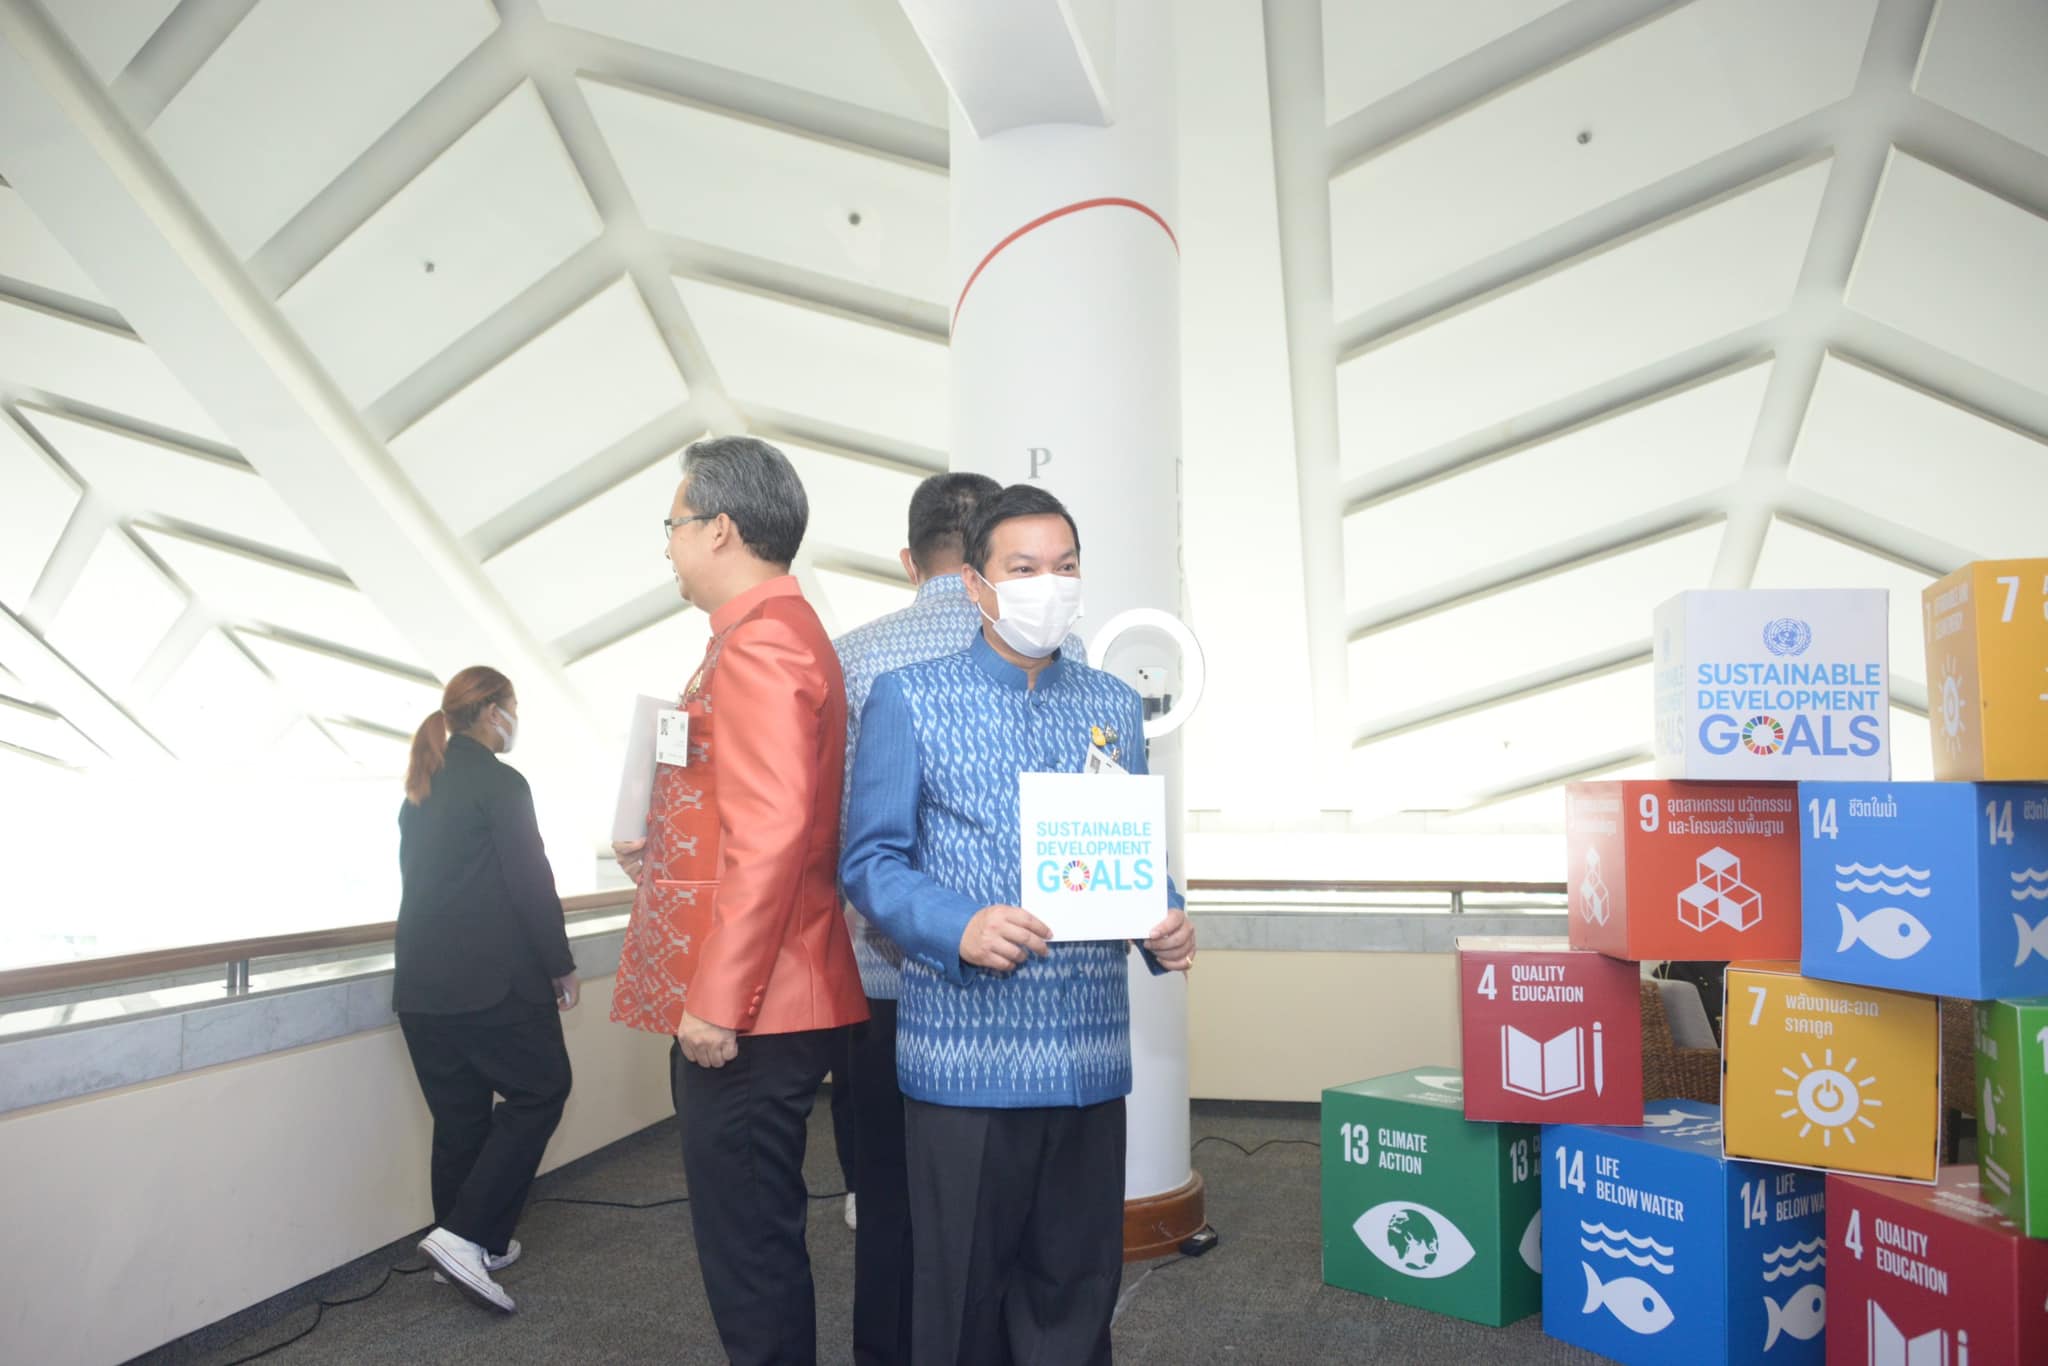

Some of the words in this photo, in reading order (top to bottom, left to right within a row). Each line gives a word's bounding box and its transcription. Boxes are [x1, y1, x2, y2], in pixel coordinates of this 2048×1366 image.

[1027, 447, 1052, 479] P
[1996, 576, 2019, 622] 7
[1697, 663, 1881, 686] SUSTAINABLE
[1699, 690, 1880, 711] DEVELOPMENT
[1699, 714, 1881, 756] GOALS
[1639, 793, 1660, 833] 9
[1667, 799, 1735, 816] อุตสาหกรรม
[1738, 796, 1792, 812] นวัตกรรม
[1808, 798, 1839, 840] 14
[1986, 800, 2015, 846] 14
[1036, 821, 1152, 837] SUSTAINABLE
[1036, 841, 1152, 856] DEVELOPMENT
[1037, 859, 1153, 893] GOALS
[1477, 964, 1497, 1000] 4
[1512, 965, 1565, 983] QUALITY
[1512, 985, 1584, 1003] EDUCATION
[1747, 986, 1767, 1025] 7
[1340, 1122, 1369, 1165] 13
[1378, 1127, 1427, 1153] CLIMATE
[1378, 1150, 1422, 1175] ACTION
[1510, 1139, 1528, 1184] 13
[1555, 1146, 1586, 1194] 14
[1595, 1154, 1620, 1179] LIFE
[1596, 1179, 1638, 1209] BELOW
[1640, 1189, 1684, 1222] WATER
[1775, 1173, 1796, 1196] LIFE
[1740, 1179, 1767, 1229] 14
[1775, 1195, 1810, 1222] BELOW
[1845, 1208, 1863, 1260] 4
[1875, 1218, 1928, 1257] QUALITY
[1876, 1247, 1947, 1296] EDUCATION
